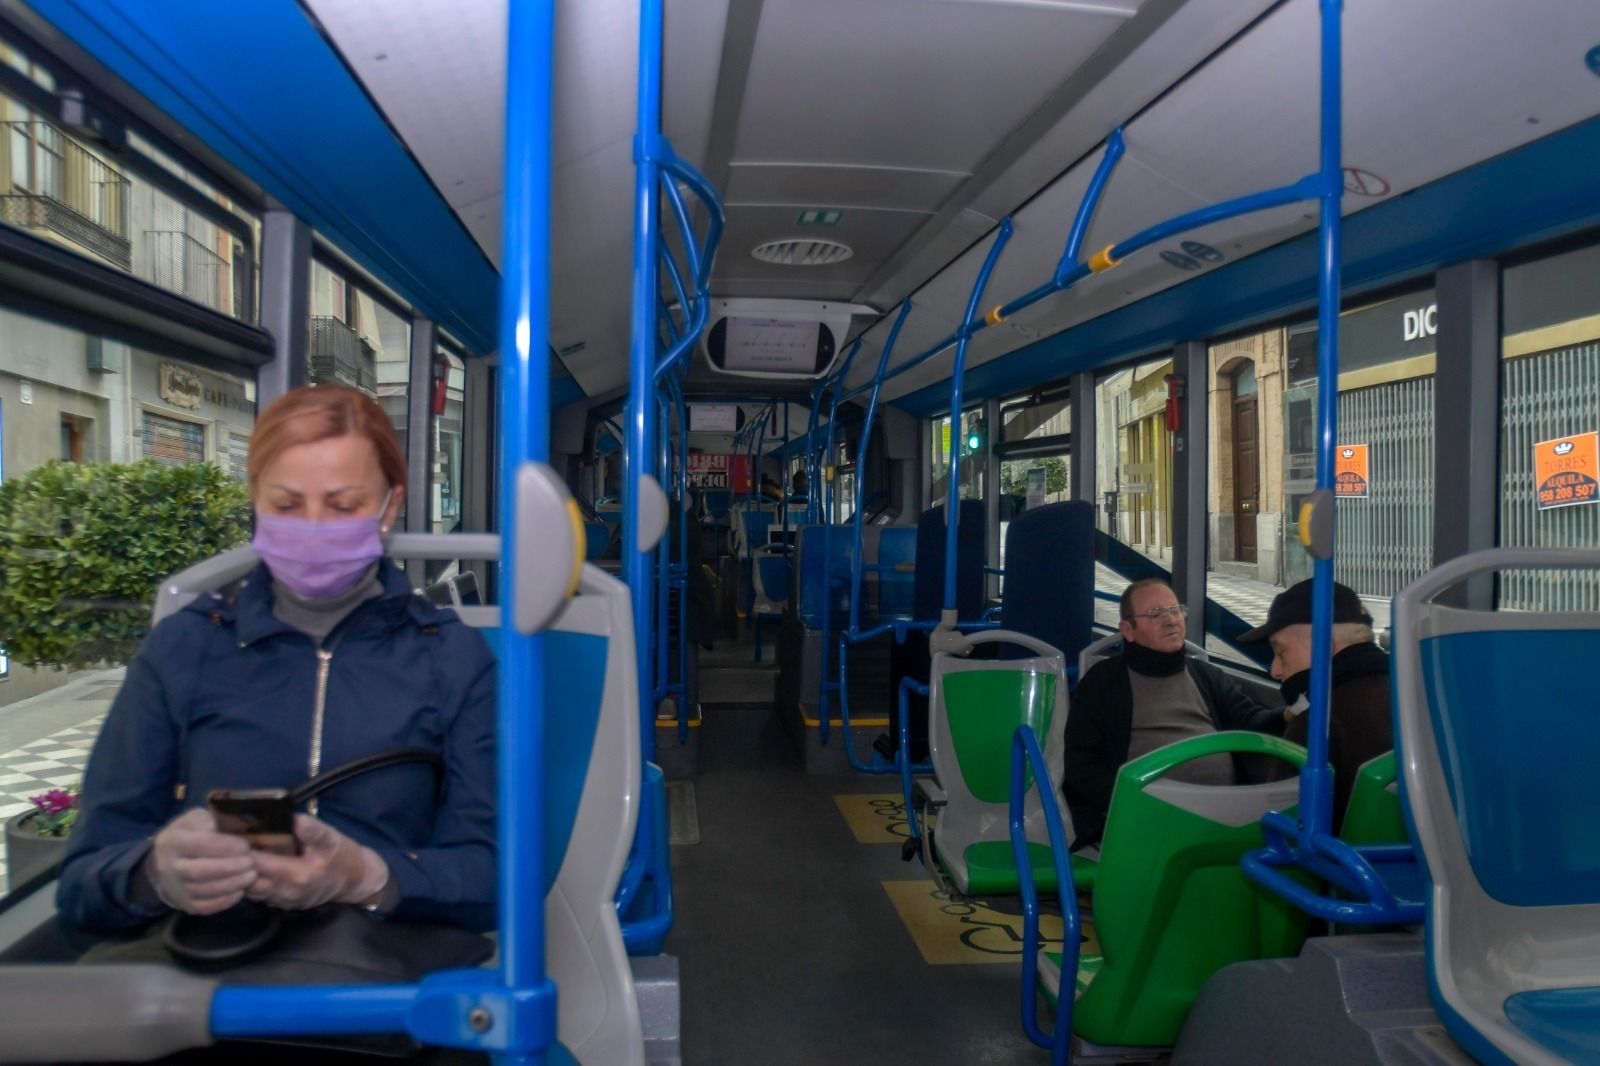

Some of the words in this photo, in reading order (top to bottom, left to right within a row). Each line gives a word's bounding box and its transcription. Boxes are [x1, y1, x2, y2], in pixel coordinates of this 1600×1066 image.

[1544, 455, 1587, 474] TORRES
[1547, 473, 1584, 488] ALQUILA
[1556, 486, 1573, 500] 208
[1575, 483, 1595, 497] 507
